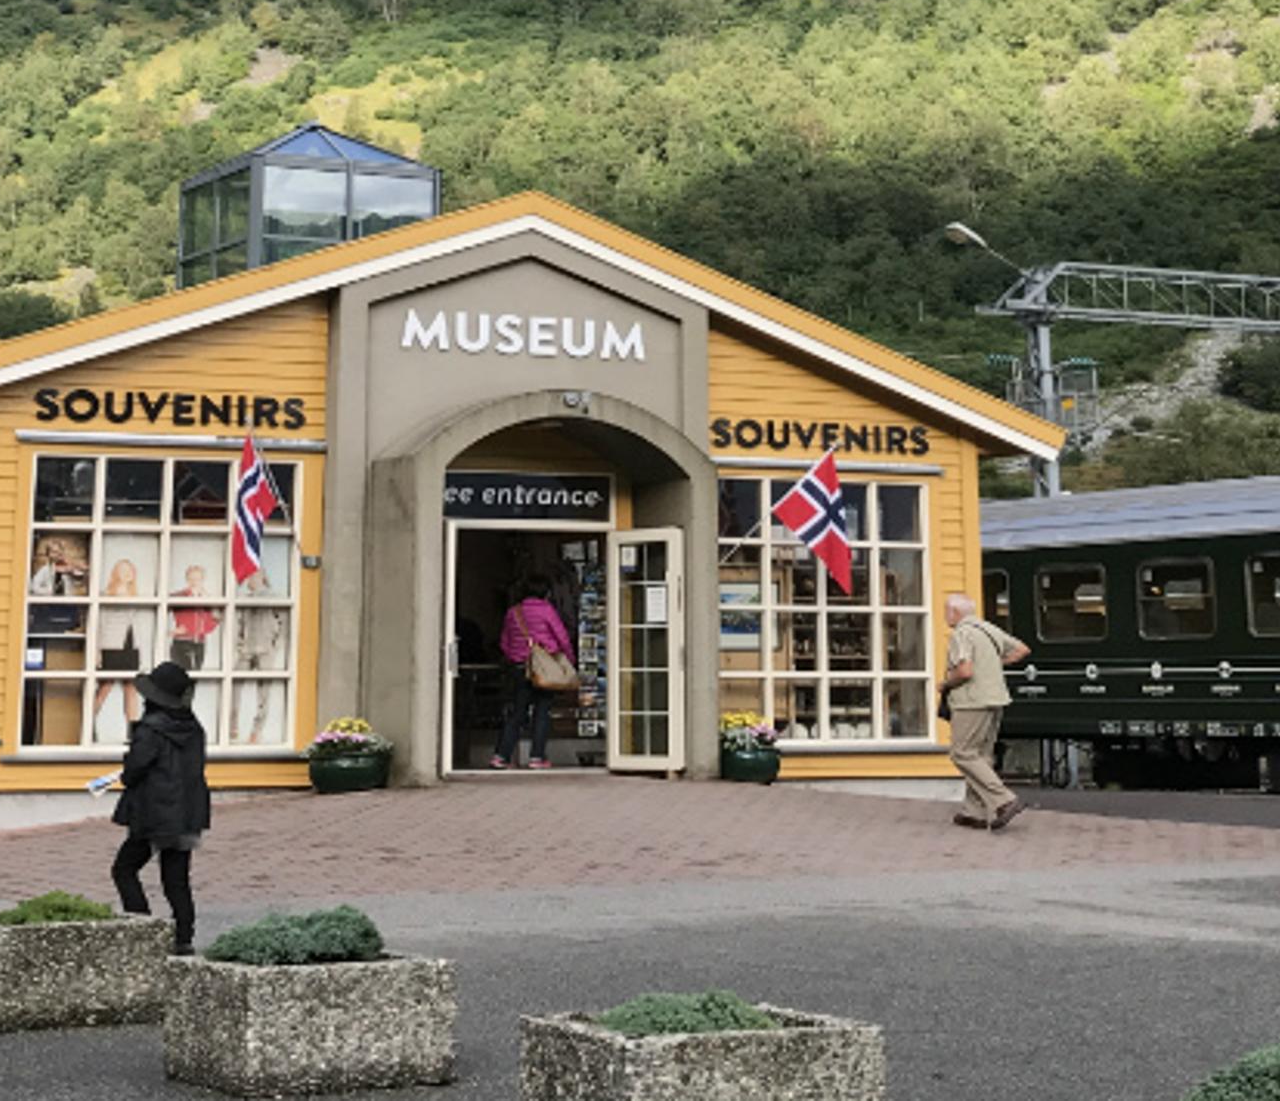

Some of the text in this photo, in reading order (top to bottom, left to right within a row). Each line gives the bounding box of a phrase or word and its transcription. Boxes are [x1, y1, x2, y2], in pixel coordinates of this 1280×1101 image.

[401, 308, 646, 361] MUSEUM
[33, 387, 307, 430] SOUVENIRS
[710, 417, 930, 456] SOUVENIRS
[481, 483, 601, 508] entrance
